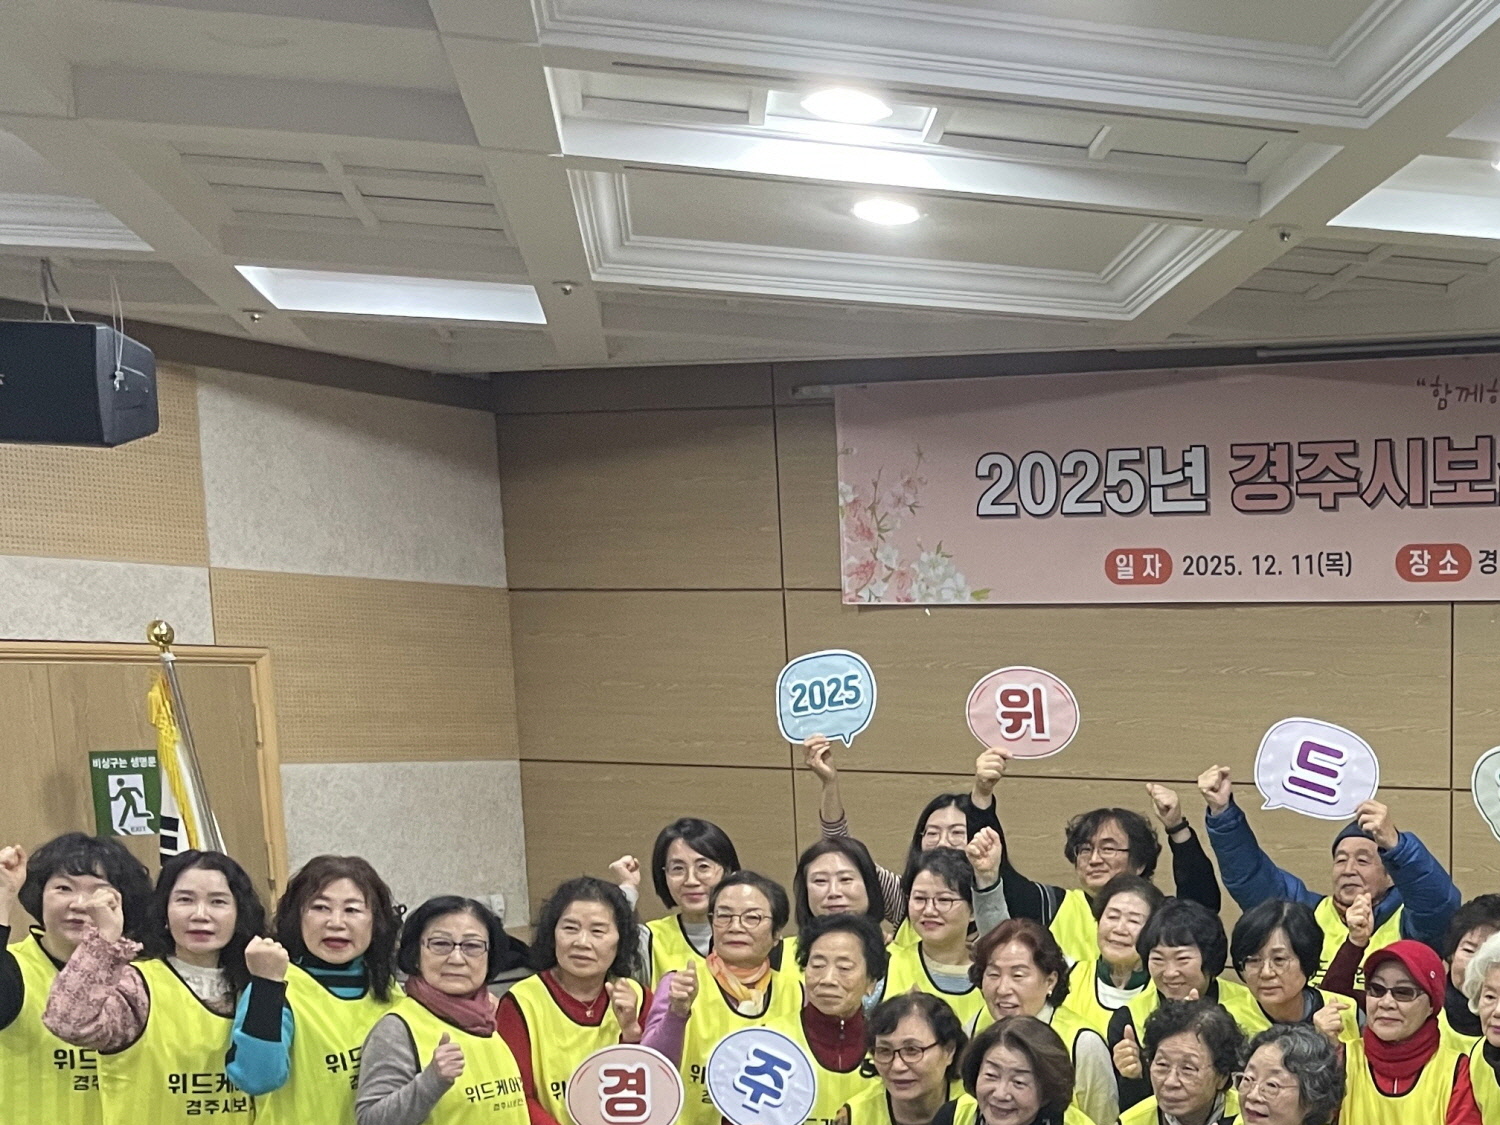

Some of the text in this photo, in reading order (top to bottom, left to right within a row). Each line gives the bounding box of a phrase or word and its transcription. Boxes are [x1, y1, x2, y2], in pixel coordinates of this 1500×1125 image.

[975, 444, 1211, 517] 2025년
[1181, 555, 1243, 577] 2025.
[1251, 554, 1284, 576] 12.
[1291, 551, 1353, 578] 11(목)
[791, 674, 863, 714] 2025
[997, 685, 1048, 737] 위
[1286, 738, 1346, 805] 드
[602, 1067, 648, 1124] 경
[735, 1044, 794, 1106] 주
